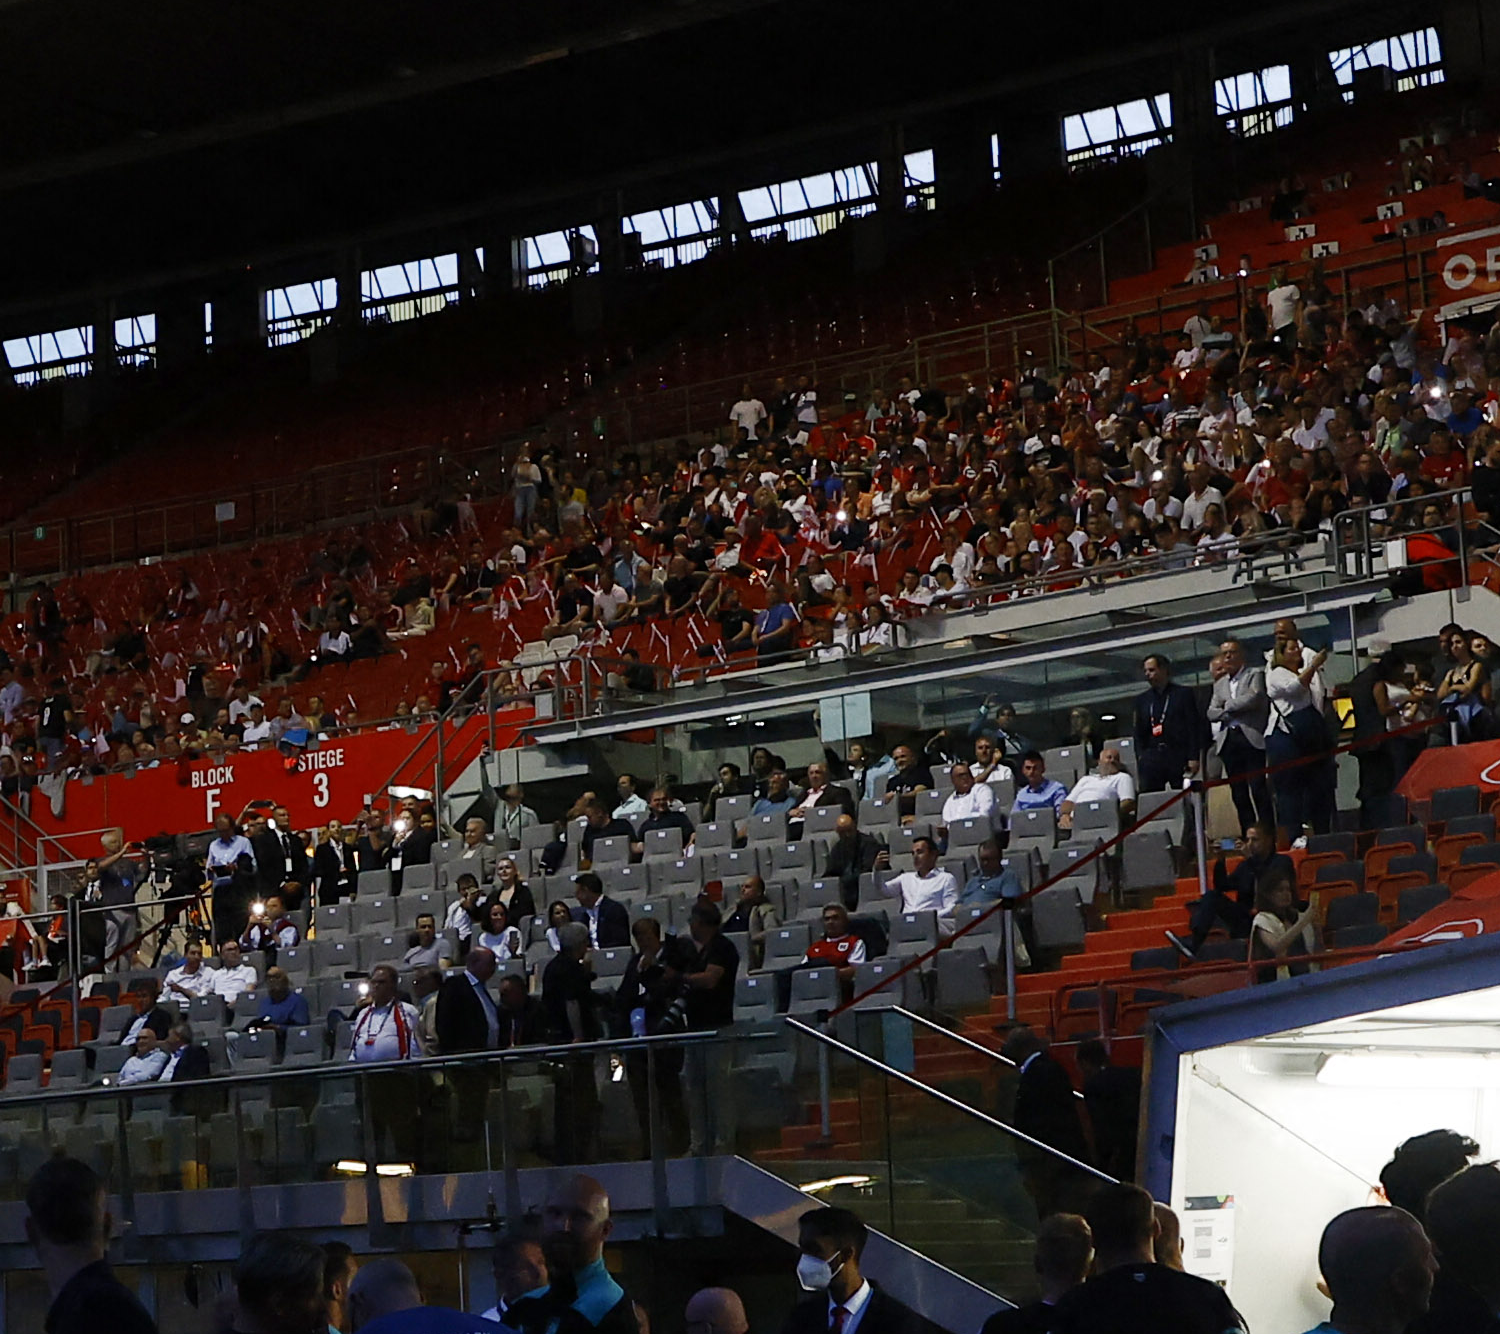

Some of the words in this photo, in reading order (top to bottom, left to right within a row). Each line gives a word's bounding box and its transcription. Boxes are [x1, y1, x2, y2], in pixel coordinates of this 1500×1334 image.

[191, 765, 235, 789] BLOCK
[297, 748, 344, 772] STIEGE
[206, 788, 221, 823] F
[313, 772, 329, 808] 3
